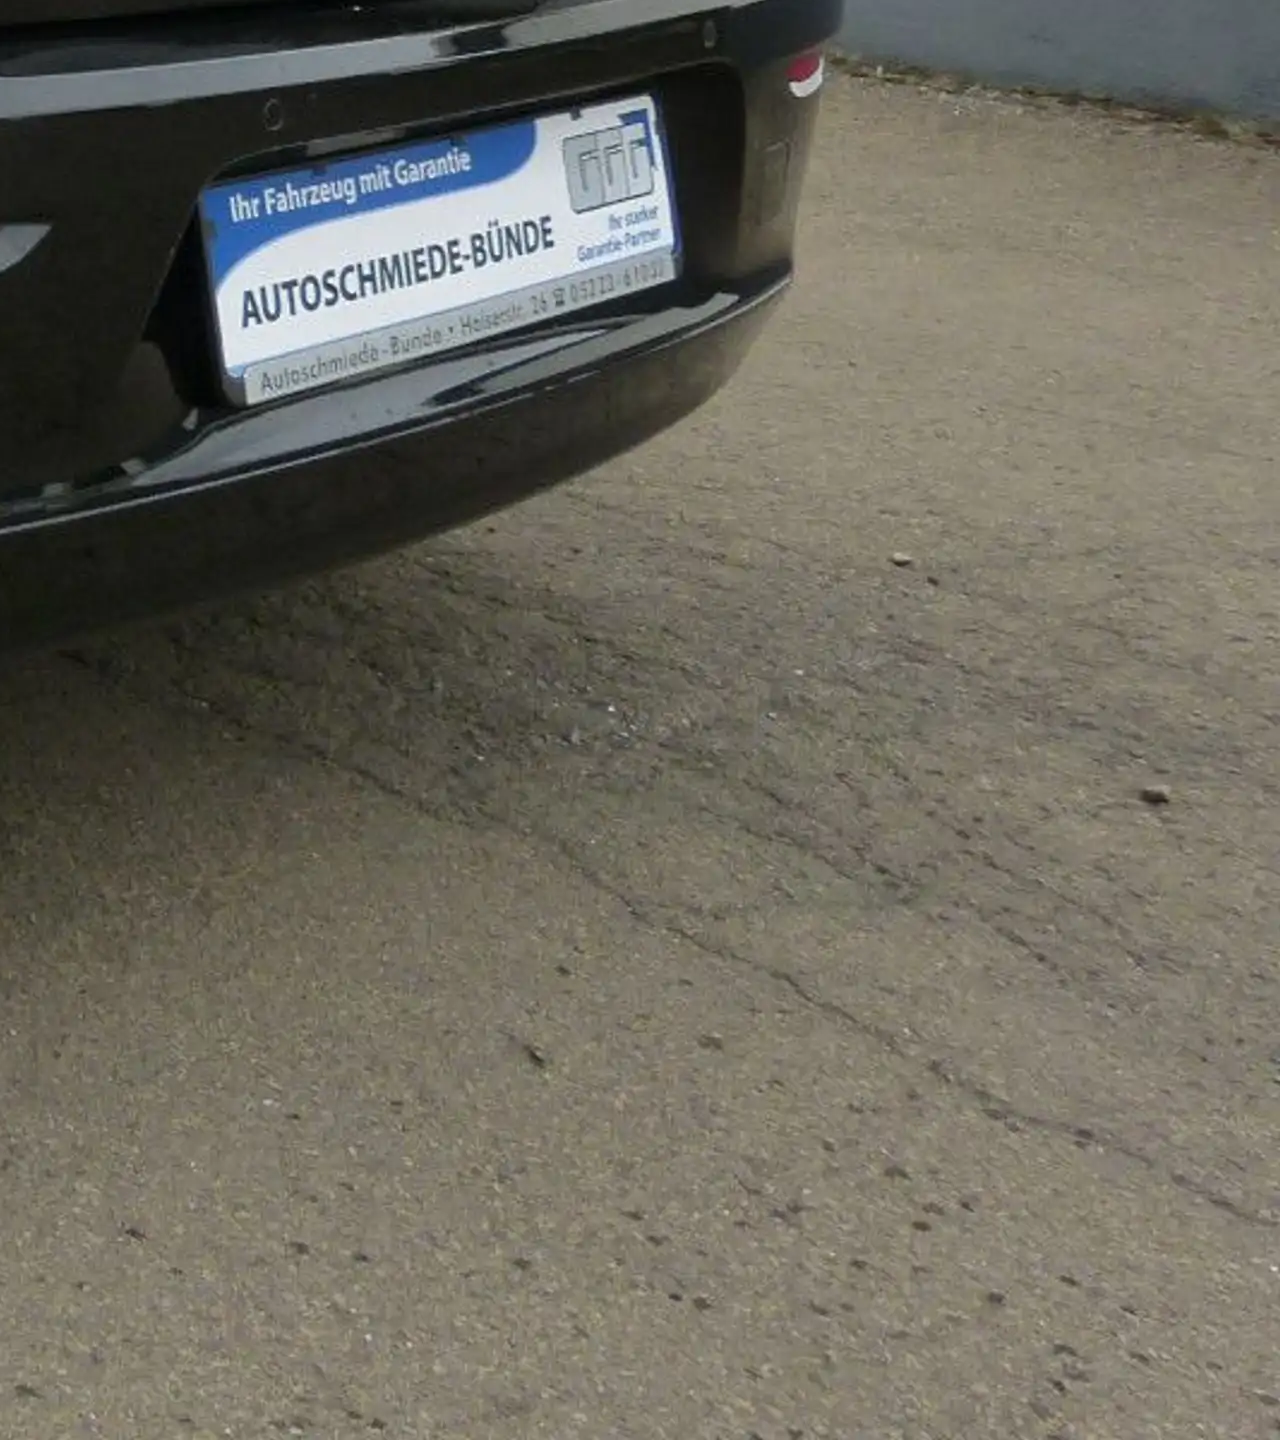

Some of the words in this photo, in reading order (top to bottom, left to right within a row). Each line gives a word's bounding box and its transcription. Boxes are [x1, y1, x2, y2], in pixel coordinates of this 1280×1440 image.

[229, 194, 260, 223] Ihr
[263, 176, 358, 216] Fahrzeug
[360, 163, 393, 194] mit
[394, 147, 473, 186] Garantie
[241, 214, 556, 328] AUTOSCHMIEDE-BÜNDE
